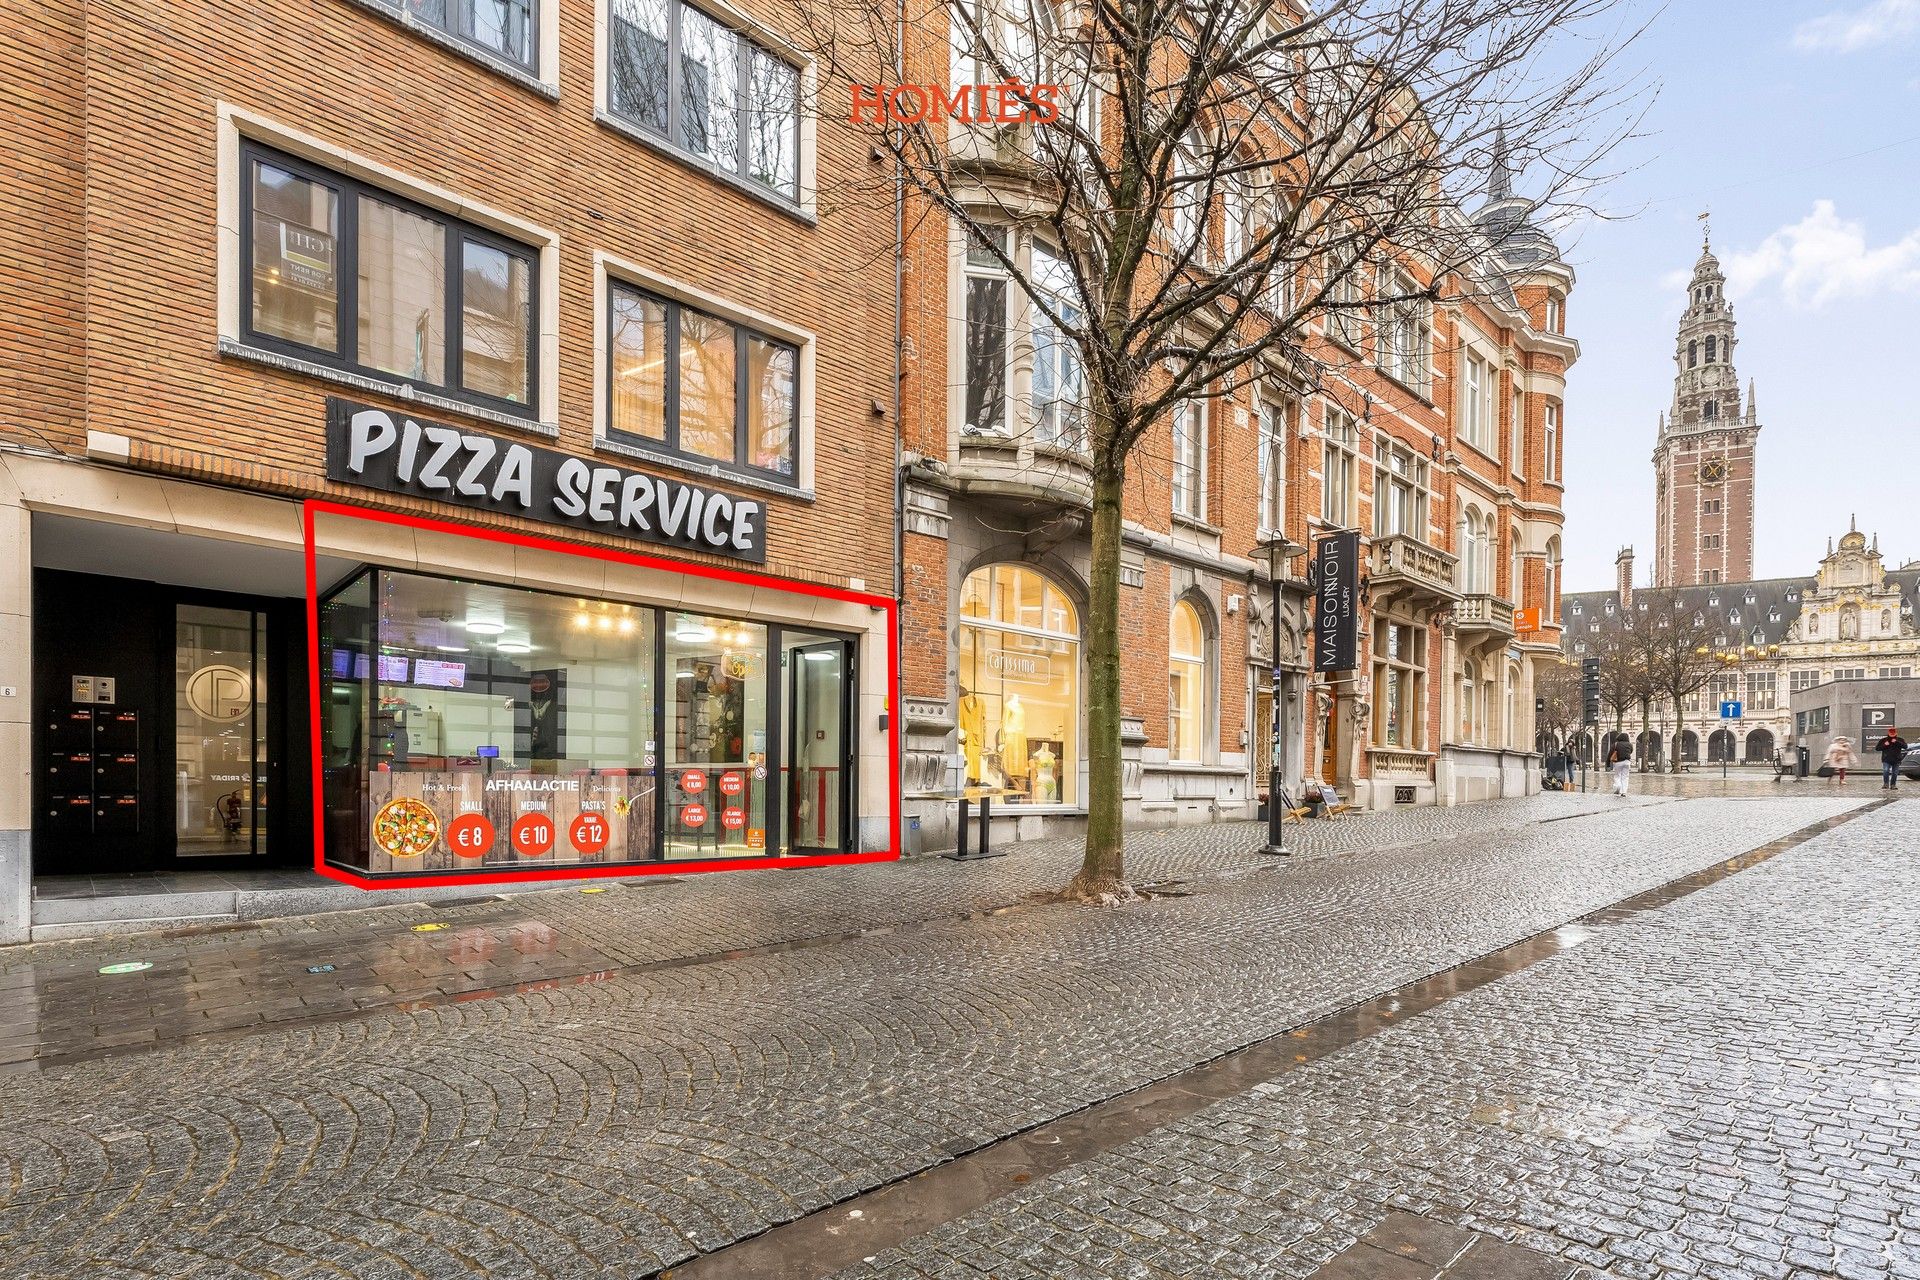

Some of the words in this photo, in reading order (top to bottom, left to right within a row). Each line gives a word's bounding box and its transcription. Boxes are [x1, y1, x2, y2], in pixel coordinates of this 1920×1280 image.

[349, 409, 533, 508] PIZZA
[553, 457, 759, 551] SERVICE
[1342, 586, 1350, 617] LUXURY
[5, 687, 11, 696] 6
[1824, 709, 1829, 719] P
[1871, 711, 1885, 725] P
[422, 784, 437, 792] Hot
[439, 784, 445, 792] &
[447, 784, 467, 792] Fresh
[485, 780, 579, 792] AFHAALACTIE
[592, 785, 621, 793] Delicious
[460, 801, 483, 811] SMALL
[520, 801, 547, 811] MEDIUM
[581, 801, 606, 811] PASTA'S
[457, 828, 469, 847] €
[473, 826, 482, 845] 8
[519, 827, 530, 845] €
[533, 825, 548, 844] 10
[576, 825, 587, 843] €
[589, 825, 602, 843] 12
